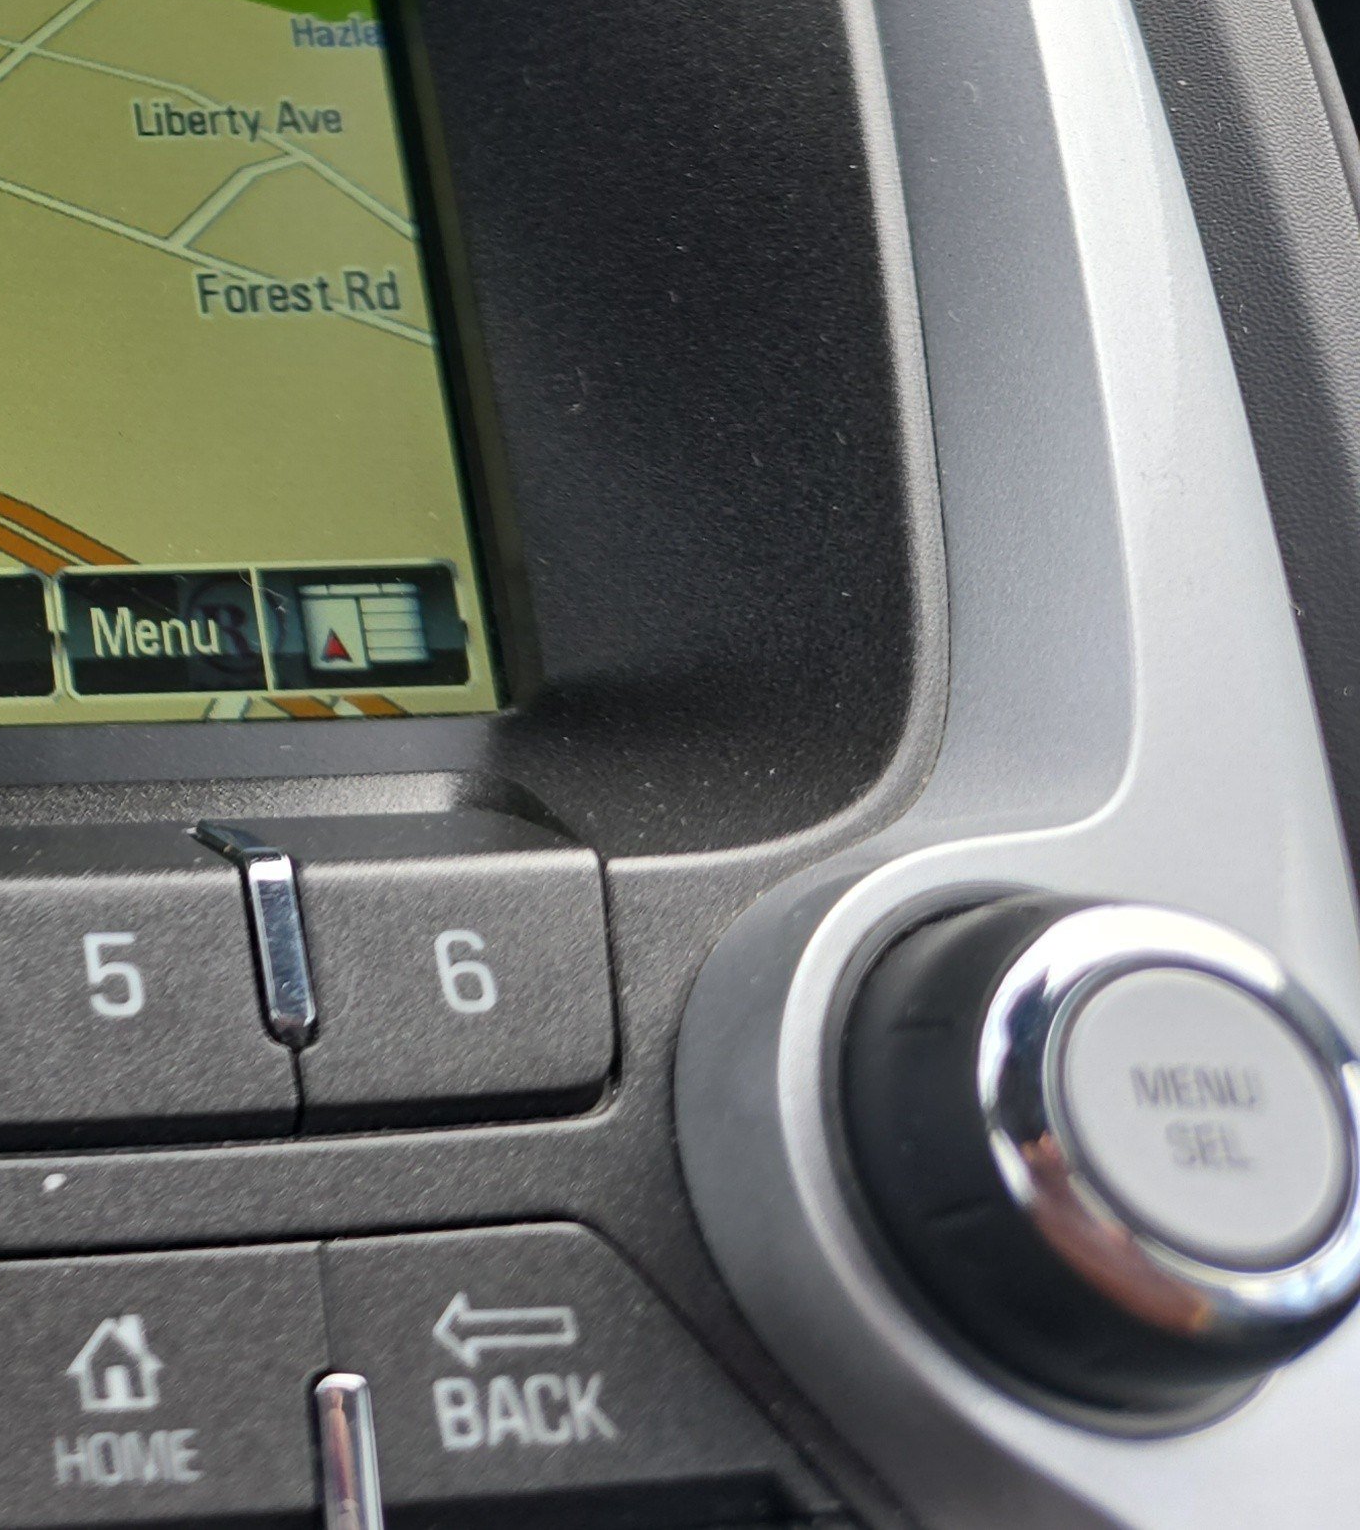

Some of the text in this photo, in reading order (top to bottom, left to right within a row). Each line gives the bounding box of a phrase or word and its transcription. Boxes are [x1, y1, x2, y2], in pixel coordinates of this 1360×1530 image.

[134, 103, 342, 141] Liberty Ave
[198, 272, 400, 314] Forest Rd
[90, 607, 222, 657] Menu
[83, 931, 146, 1018] 5
[433, 929, 499, 1014] 6
[1132, 1066, 1260, 1110] MENU
[1164, 1120, 1251, 1170] SEL
[433, 1372, 620, 1453] BACK
[53, 1428, 204, 1490] HOME
